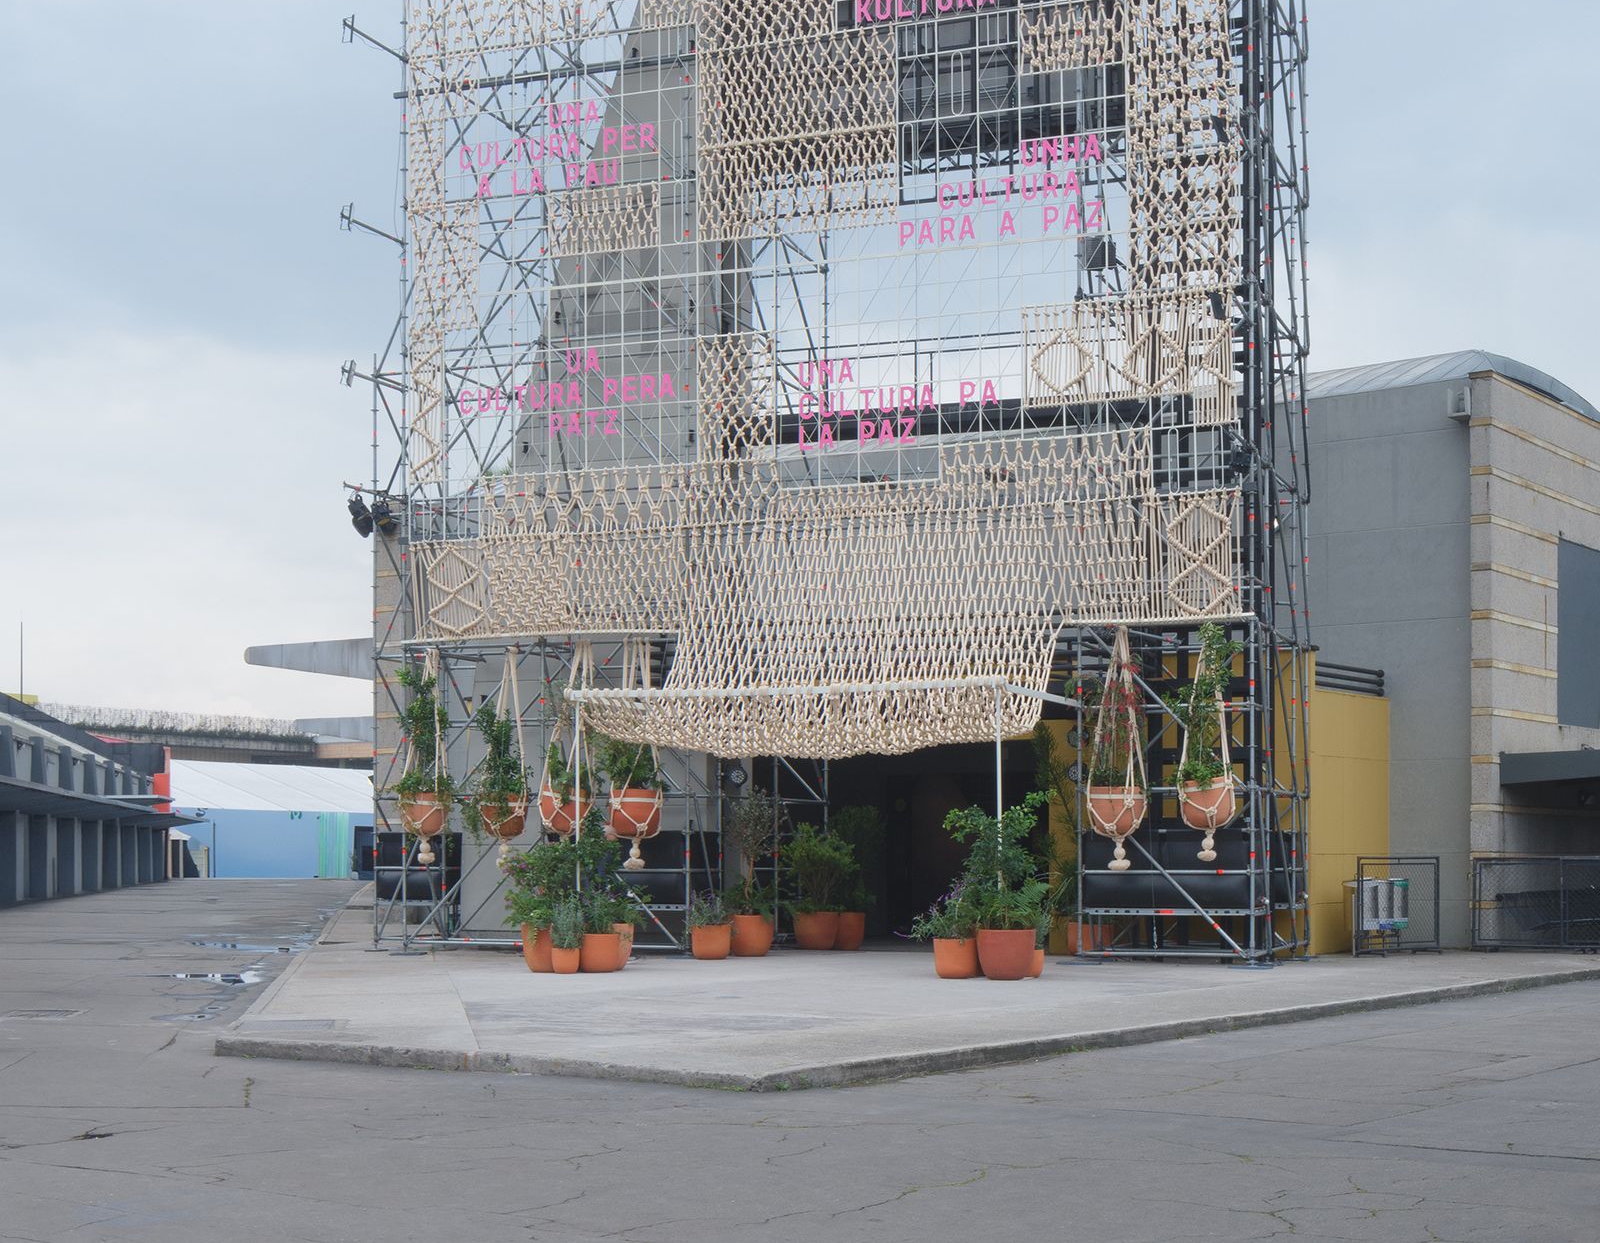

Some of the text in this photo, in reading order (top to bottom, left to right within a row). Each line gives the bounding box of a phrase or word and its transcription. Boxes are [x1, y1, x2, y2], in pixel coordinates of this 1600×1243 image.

[550, 100, 600, 129] UNA
[460, 123, 656, 170] CULTURA PER
[1021, 134, 1102, 167] UNHA
[478, 159, 618, 198] A LA PAU
[939, 170, 1081, 210] CULTURA
[900, 201, 1103, 247] PARA A PAZ
[566, 348, 601, 374] UA
[800, 358, 854, 388] UNA
[460, 373, 676, 415] CULTURA PERA
[800, 379, 998, 420] CULTURA PA
[550, 410, 619, 438] PATZ
[800, 417, 916, 451] LA PAZ
